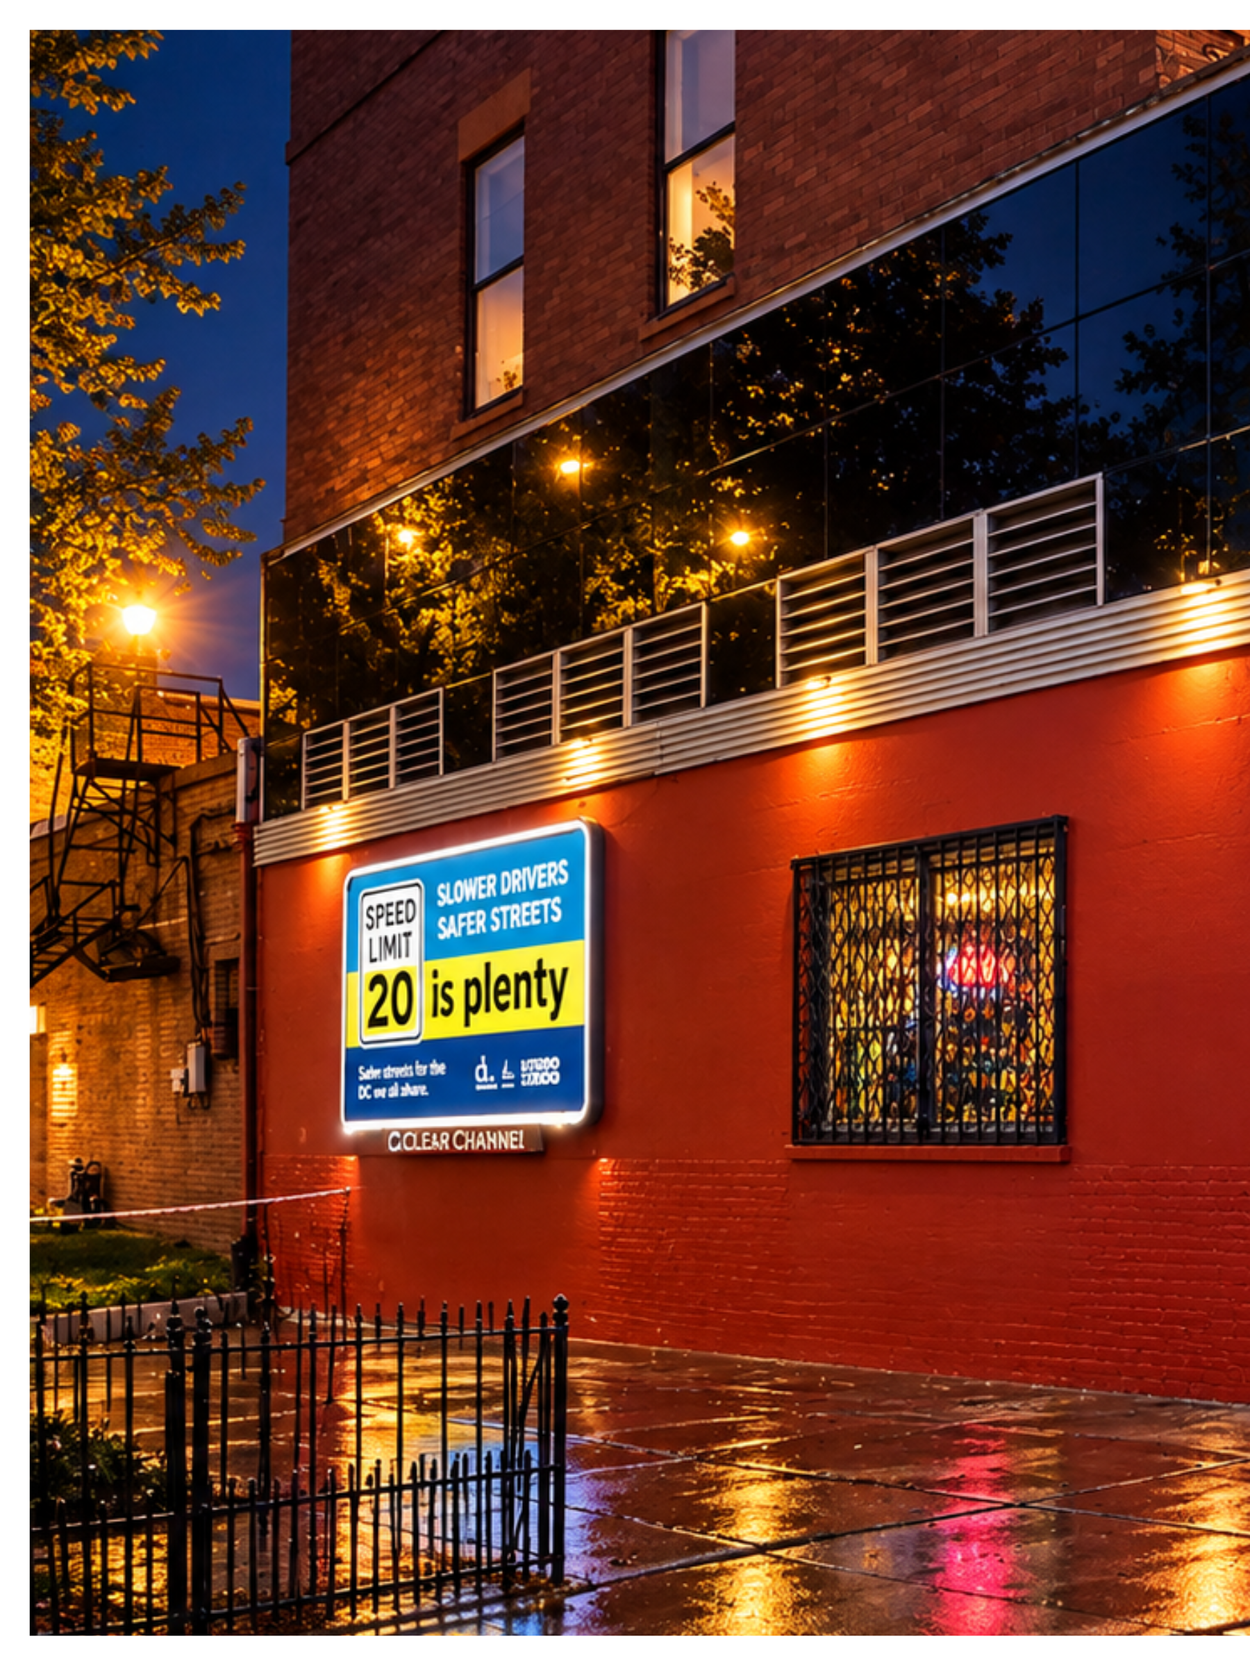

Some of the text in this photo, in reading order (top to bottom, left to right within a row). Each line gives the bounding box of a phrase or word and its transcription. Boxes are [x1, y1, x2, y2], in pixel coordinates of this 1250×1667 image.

[437, 858, 569, 907] SLOWER DRIVERS
[366, 898, 416, 930] SPEED
[437, 896, 562, 940] SAFER STREETS
[369, 930, 412, 963] LIMIT
[367, 970, 413, 1028] 20
[431, 957, 569, 1027] is plenty
[358, 1084, 372, 1100] DC
[452, 1129, 525, 1151] CHANNEL
